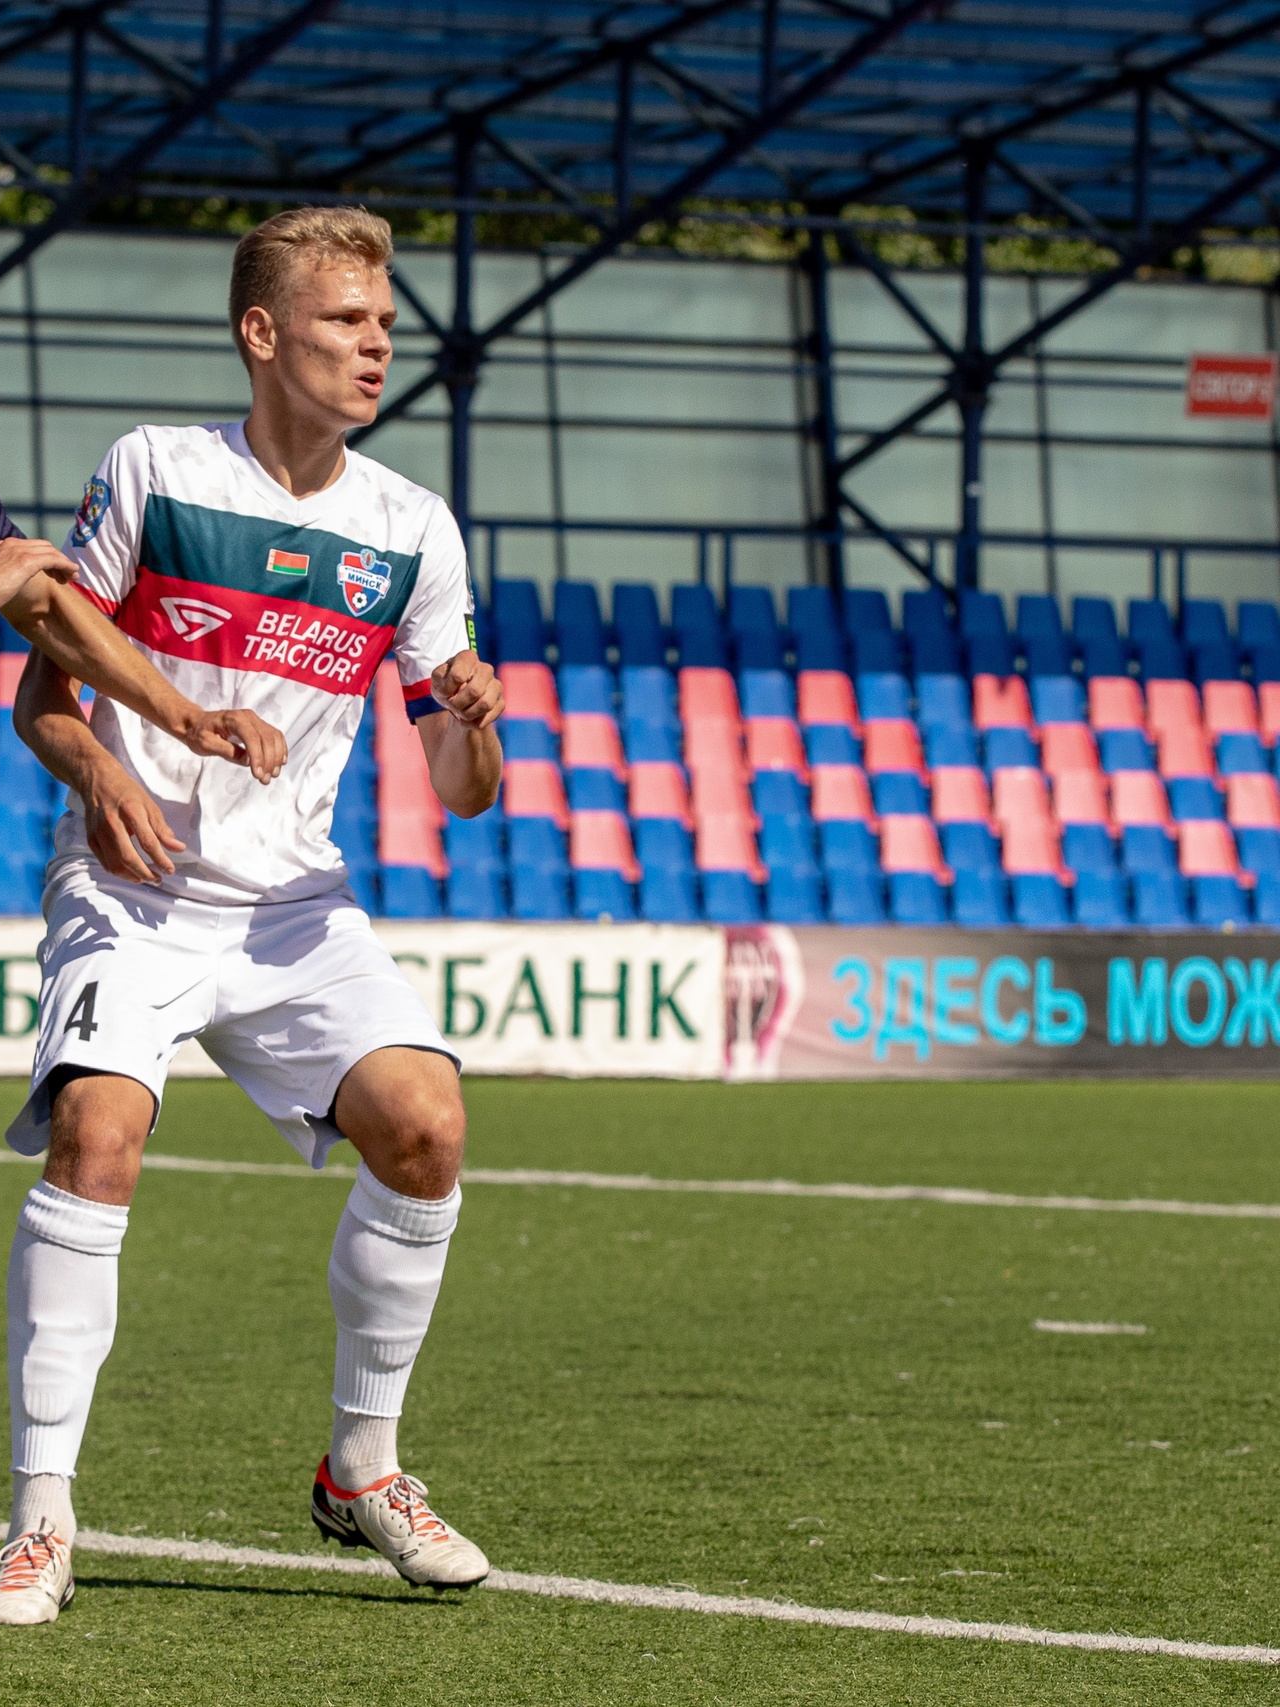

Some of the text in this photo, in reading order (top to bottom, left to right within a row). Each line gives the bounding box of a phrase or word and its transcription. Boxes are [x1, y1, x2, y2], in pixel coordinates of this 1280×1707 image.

[347, 572, 382, 590] МИНСК
[256, 610, 368, 658] BELARUS
[63, 980, 99, 1042] 4
[829, 956, 1087, 1061] ЗДЕСЬ
